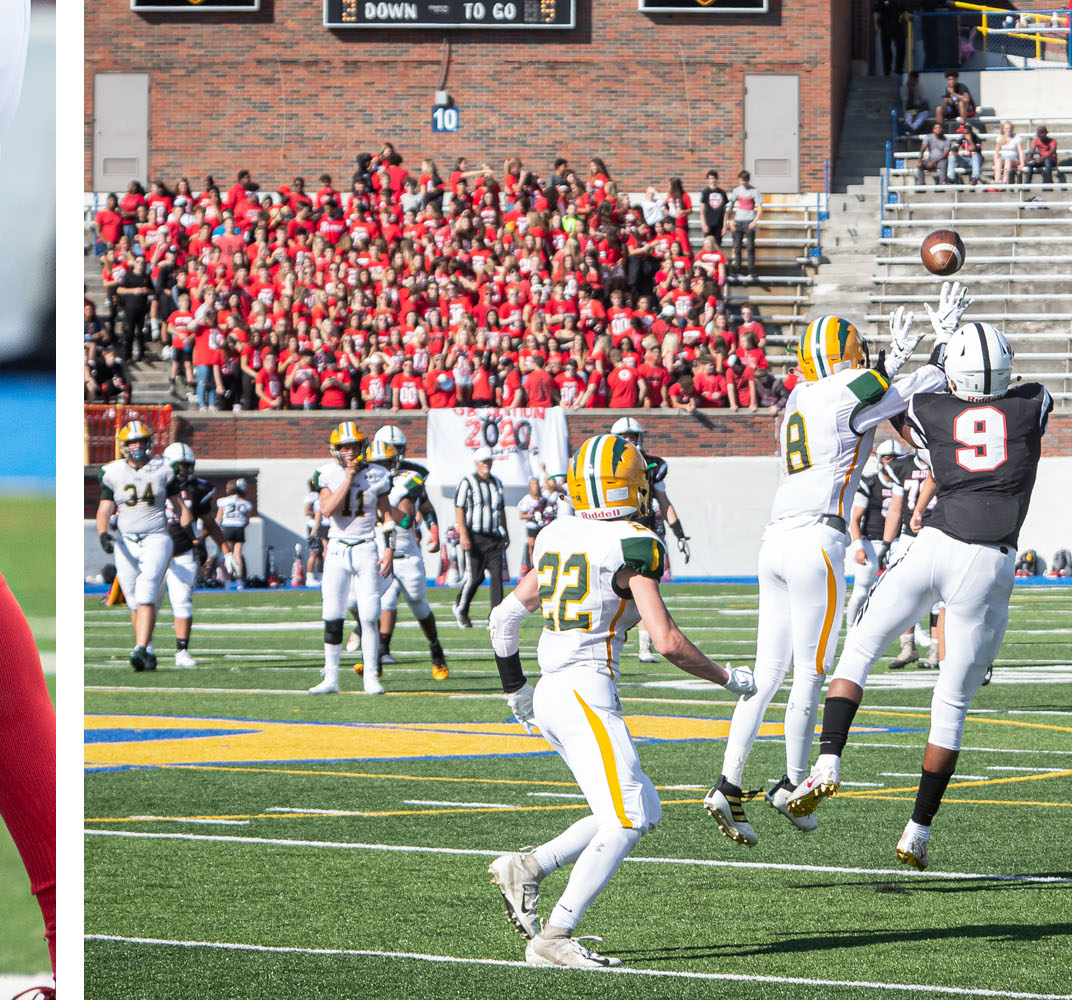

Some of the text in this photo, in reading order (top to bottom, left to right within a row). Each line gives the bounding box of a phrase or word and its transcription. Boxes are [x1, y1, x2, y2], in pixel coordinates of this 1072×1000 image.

[342, 0, 357, 22] 2
[364, 2, 418, 20] DOWN
[463, 2, 485, 20] TO
[492, 2, 517, 20] GO
[433, 107, 457, 131] 10
[464, 416, 532, 451] 2020
[786, 410, 813, 476] 8
[953, 405, 1007, 473] 9
[123, 482, 155, 508] 34
[341, 489, 365, 517] 11
[581, 509, 621, 520] Riddell
[537, 551, 592, 632] 22
